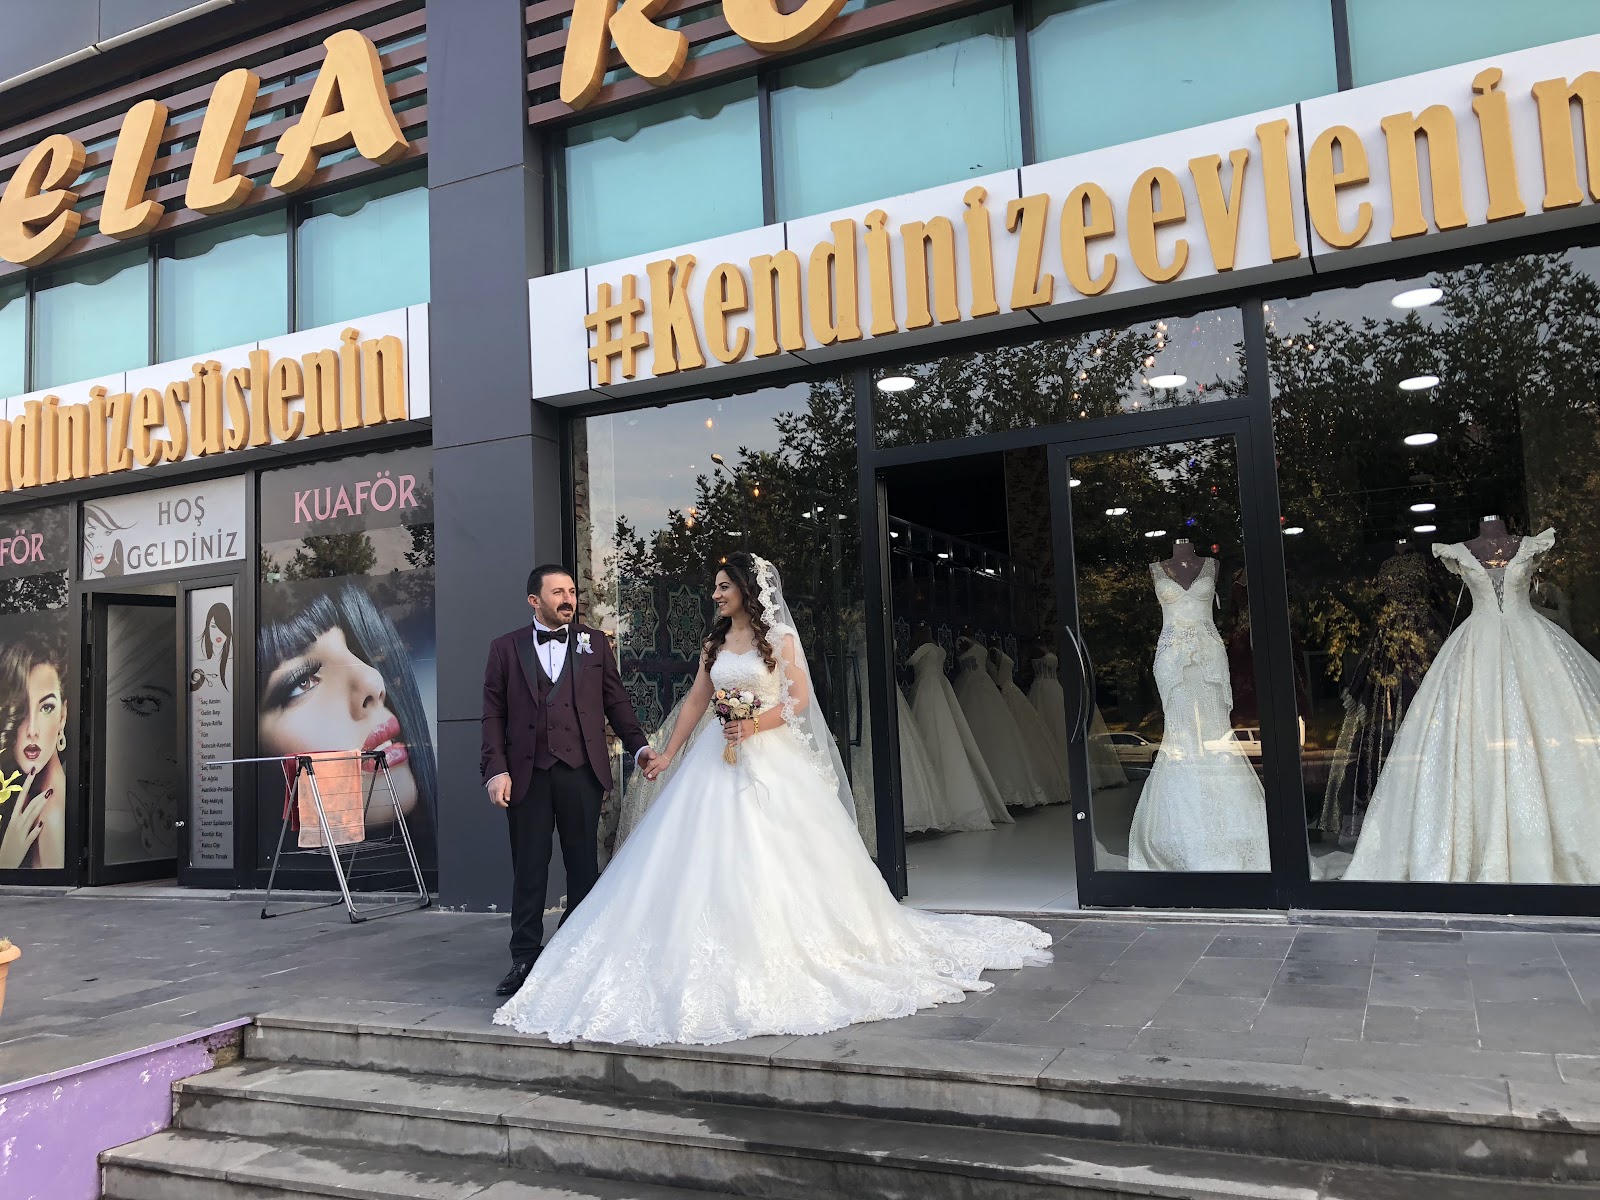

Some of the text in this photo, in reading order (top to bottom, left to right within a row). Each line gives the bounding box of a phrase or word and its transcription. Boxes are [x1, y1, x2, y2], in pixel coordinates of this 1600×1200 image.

[584, 67, 1600, 387] #Kendinizeevlenin
[158, 496, 205, 526] HOŞ
[293, 471, 418, 524] KUAFÖR
[127, 531, 238, 571] GELDİNİZ
